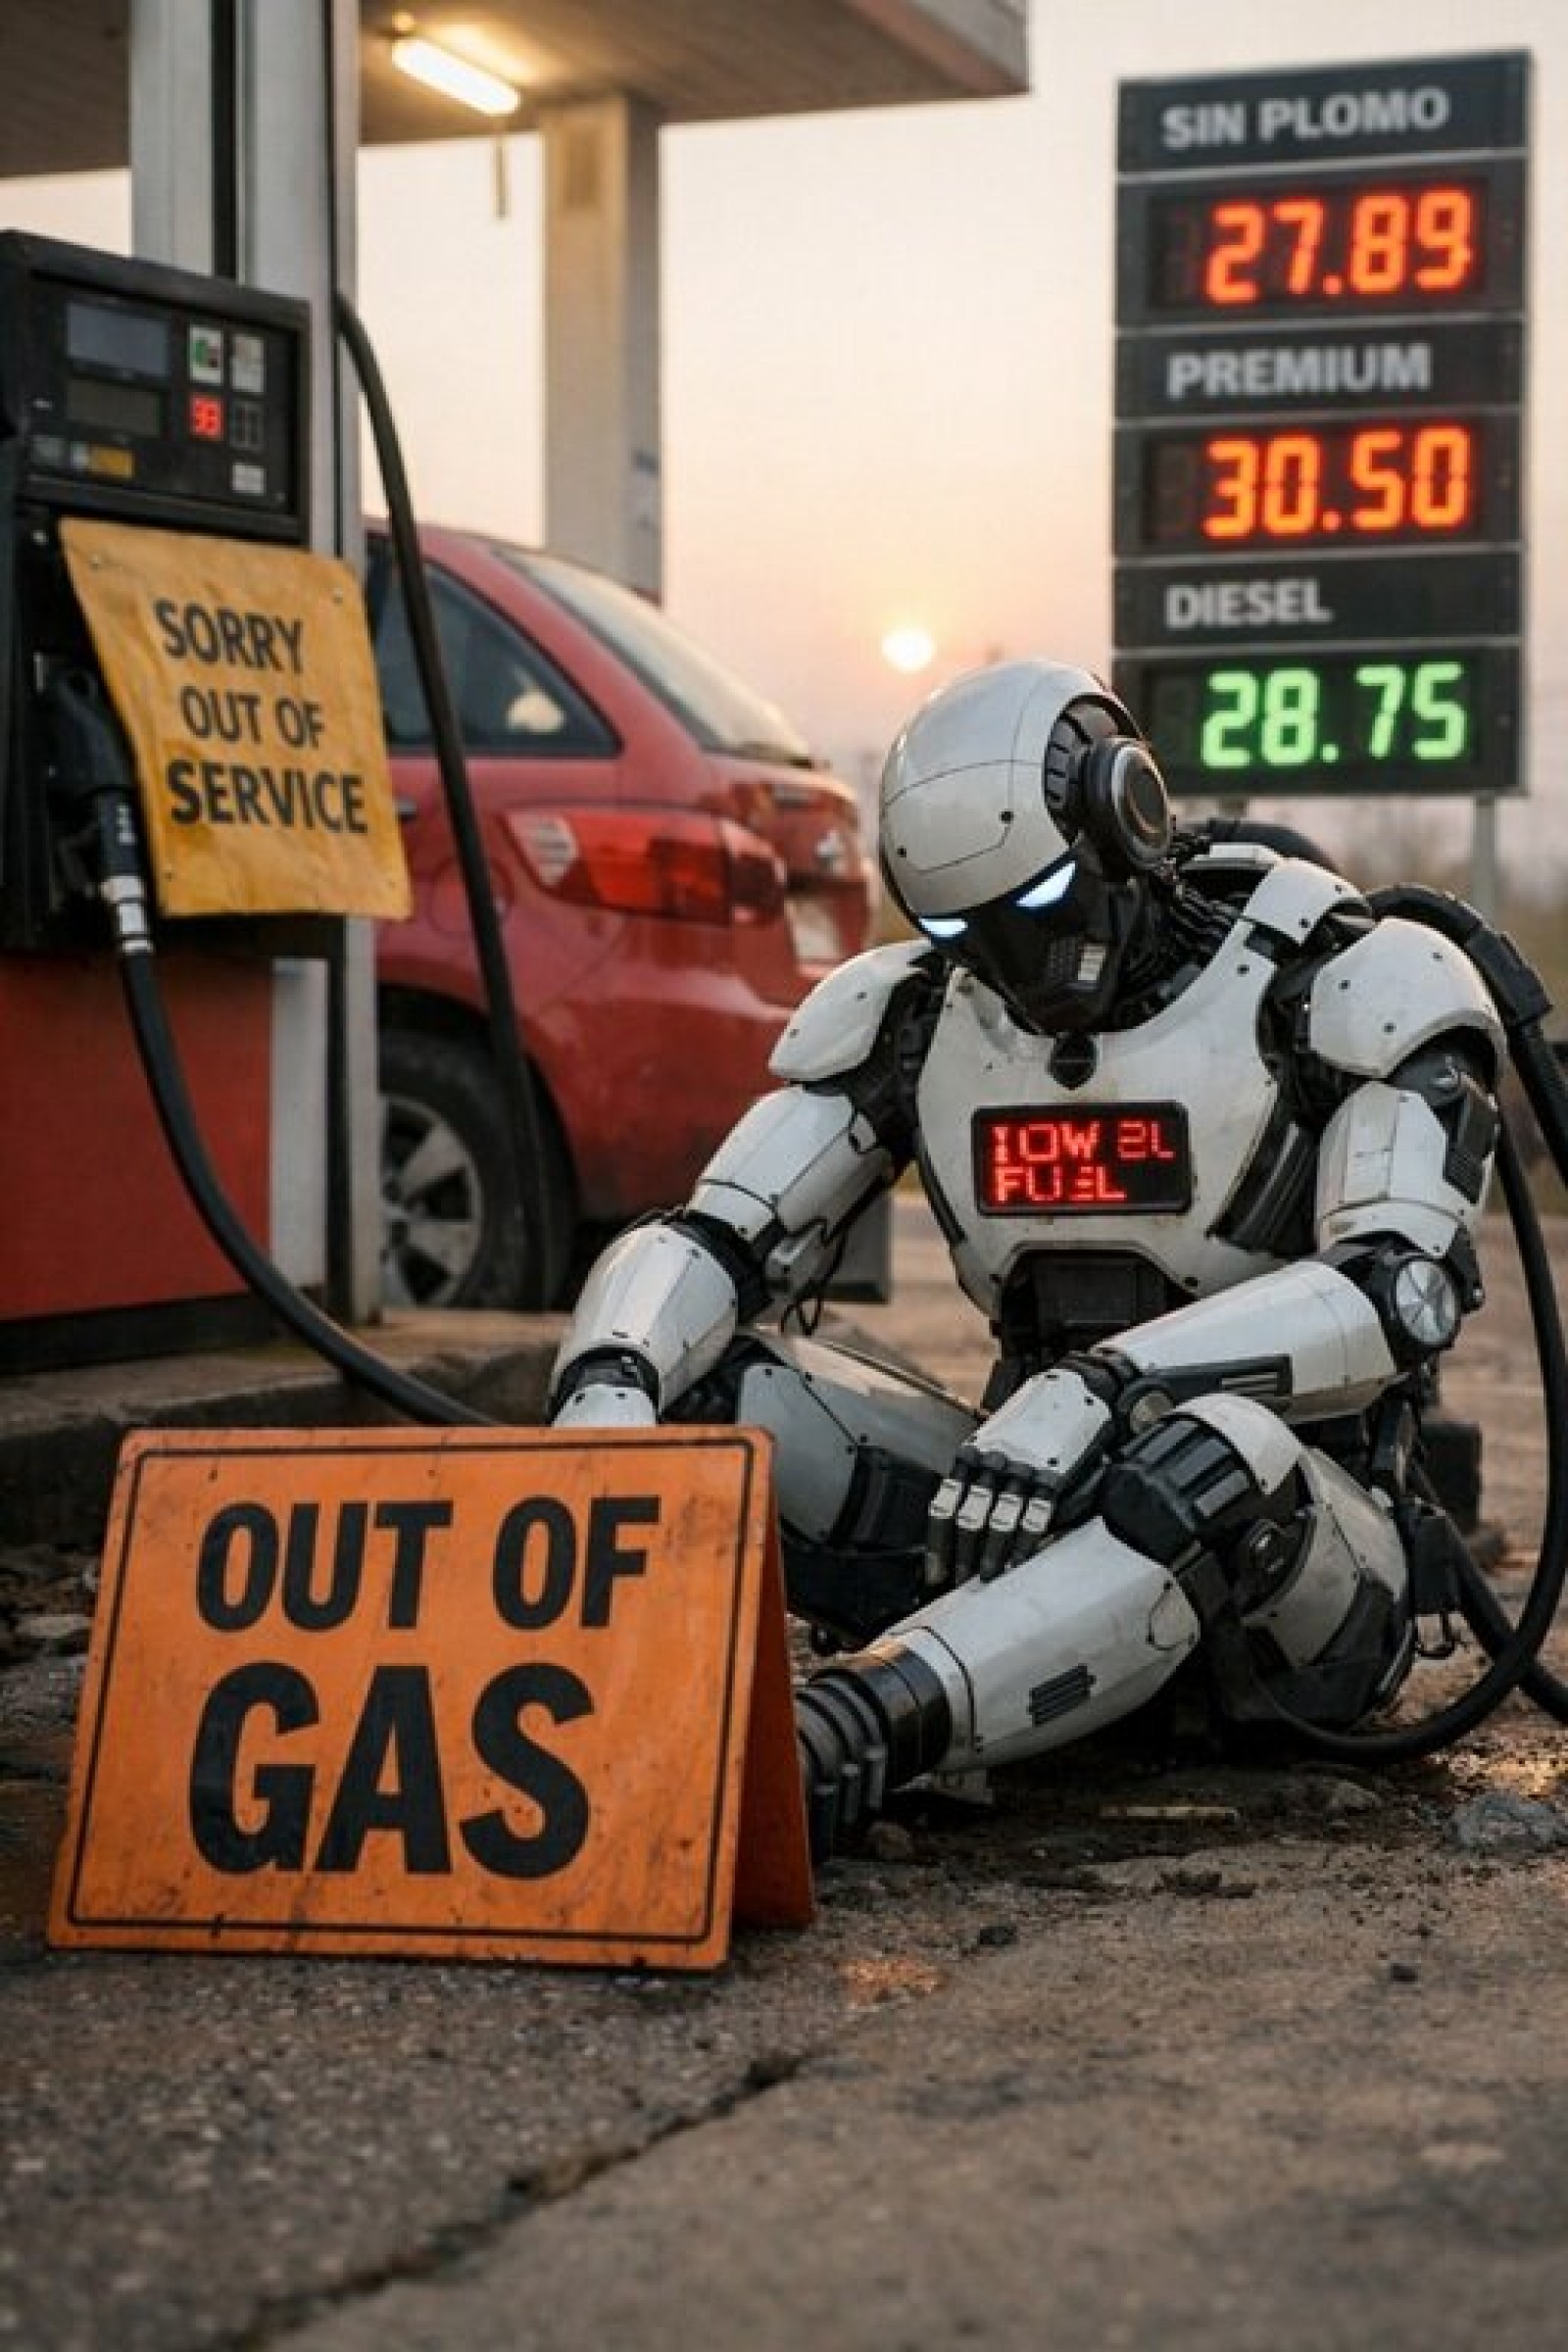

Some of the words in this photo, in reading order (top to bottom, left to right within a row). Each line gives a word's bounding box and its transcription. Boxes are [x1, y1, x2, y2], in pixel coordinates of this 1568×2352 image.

[1162, 103, 1246, 150] SIN
[1259, 86, 1450, 143] PLOMO
[1205, 189, 1473, 304] 27.89
[1167, 343, 1432, 401] PREMIUM
[1202, 426, 1470, 538] 30.50
[154, 597, 303, 674] SORRY
[1165, 579, 1334, 629] DIESEL
[179, 685, 262, 744] OUT
[273, 697, 325, 750] OF
[1200, 662, 1467, 768] 28.75
[166, 759, 368, 835] SERVICE
[994, 1165, 1126, 1202] FUEL
[196, 1499, 454, 1633] OUT
[492, 1495, 662, 1630] OF
[189, 1661, 595, 1879] GAS
